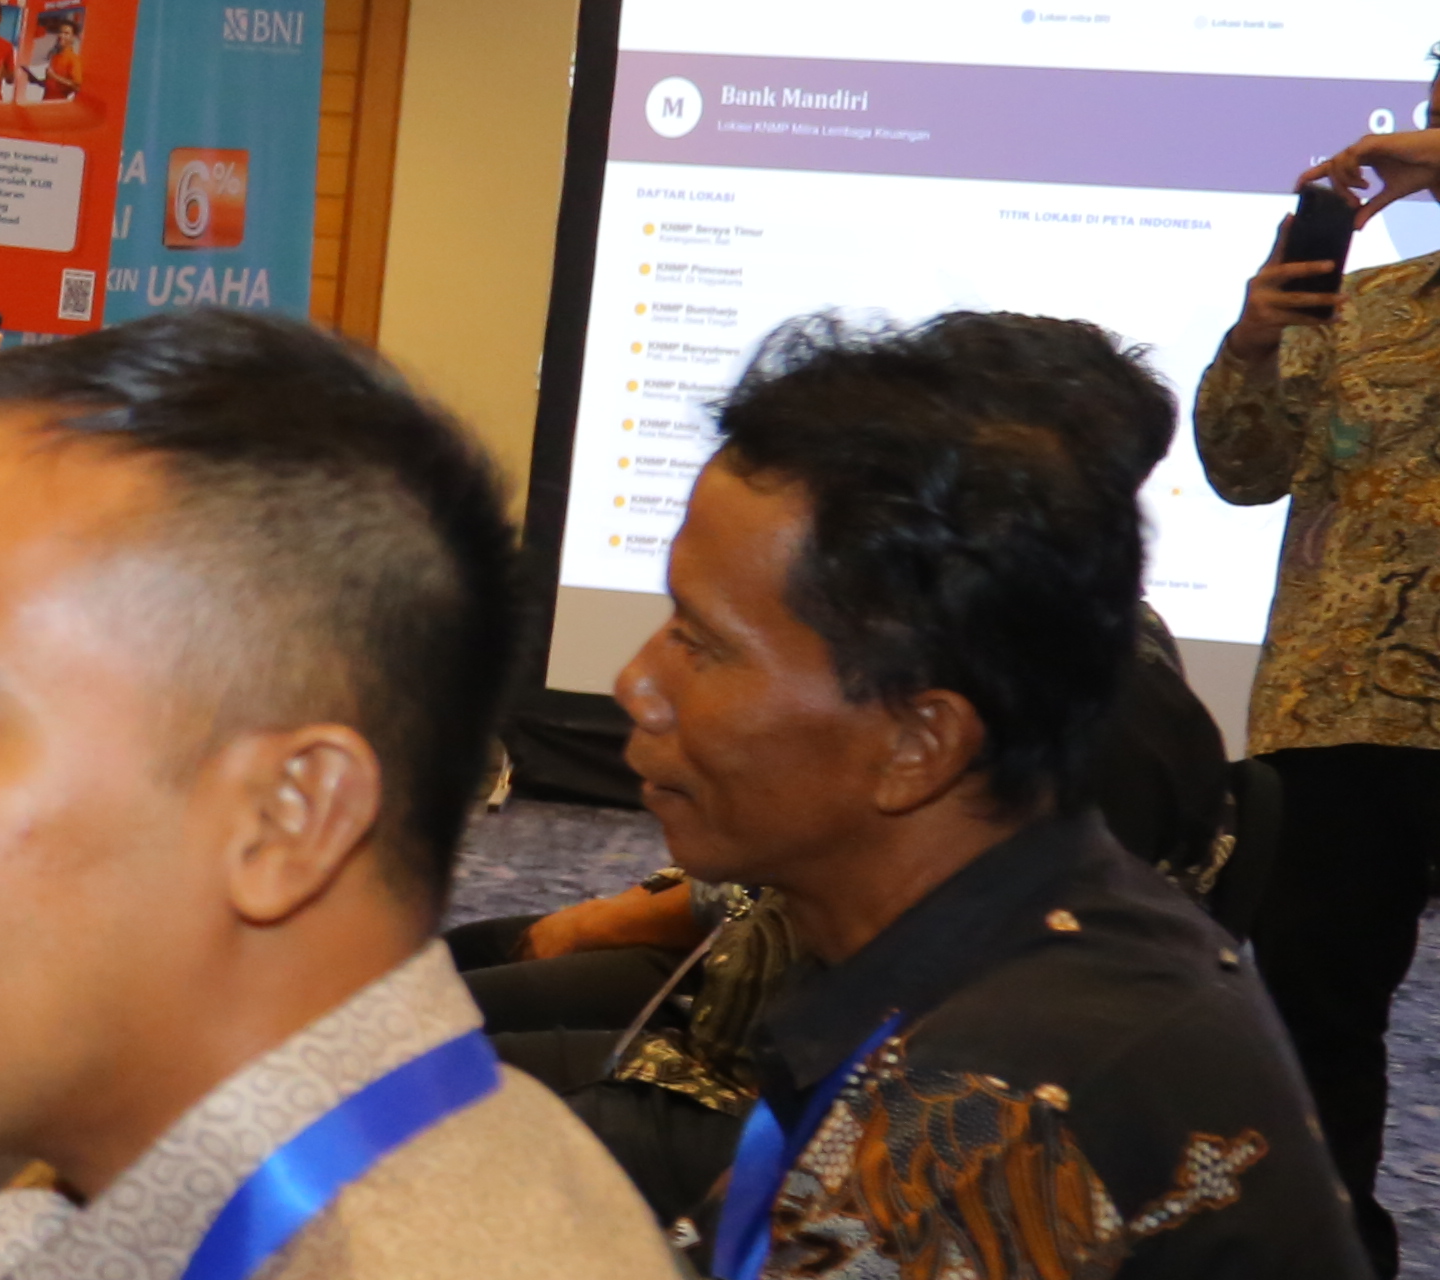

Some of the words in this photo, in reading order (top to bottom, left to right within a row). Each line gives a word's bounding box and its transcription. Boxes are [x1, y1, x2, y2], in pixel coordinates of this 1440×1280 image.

[253, 9, 304, 45] BNI
[662, 96, 685, 119] M
[720, 85, 777, 108] Bank
[782, 87, 869, 111] Mandiri
[117, 150, 147, 184] A
[636, 186, 686, 201] DAFTAR
[689, 190, 736, 203] LOKASI
[999, 209, 1030, 221] TITIK
[1035, 211, 1082, 224] LOKASI
[1086, 214, 1099, 225] DI
[1103, 215, 1135, 226] PETA
[1139, 217, 1212, 230] INDONESIA
[147, 266, 270, 308] USAHA
